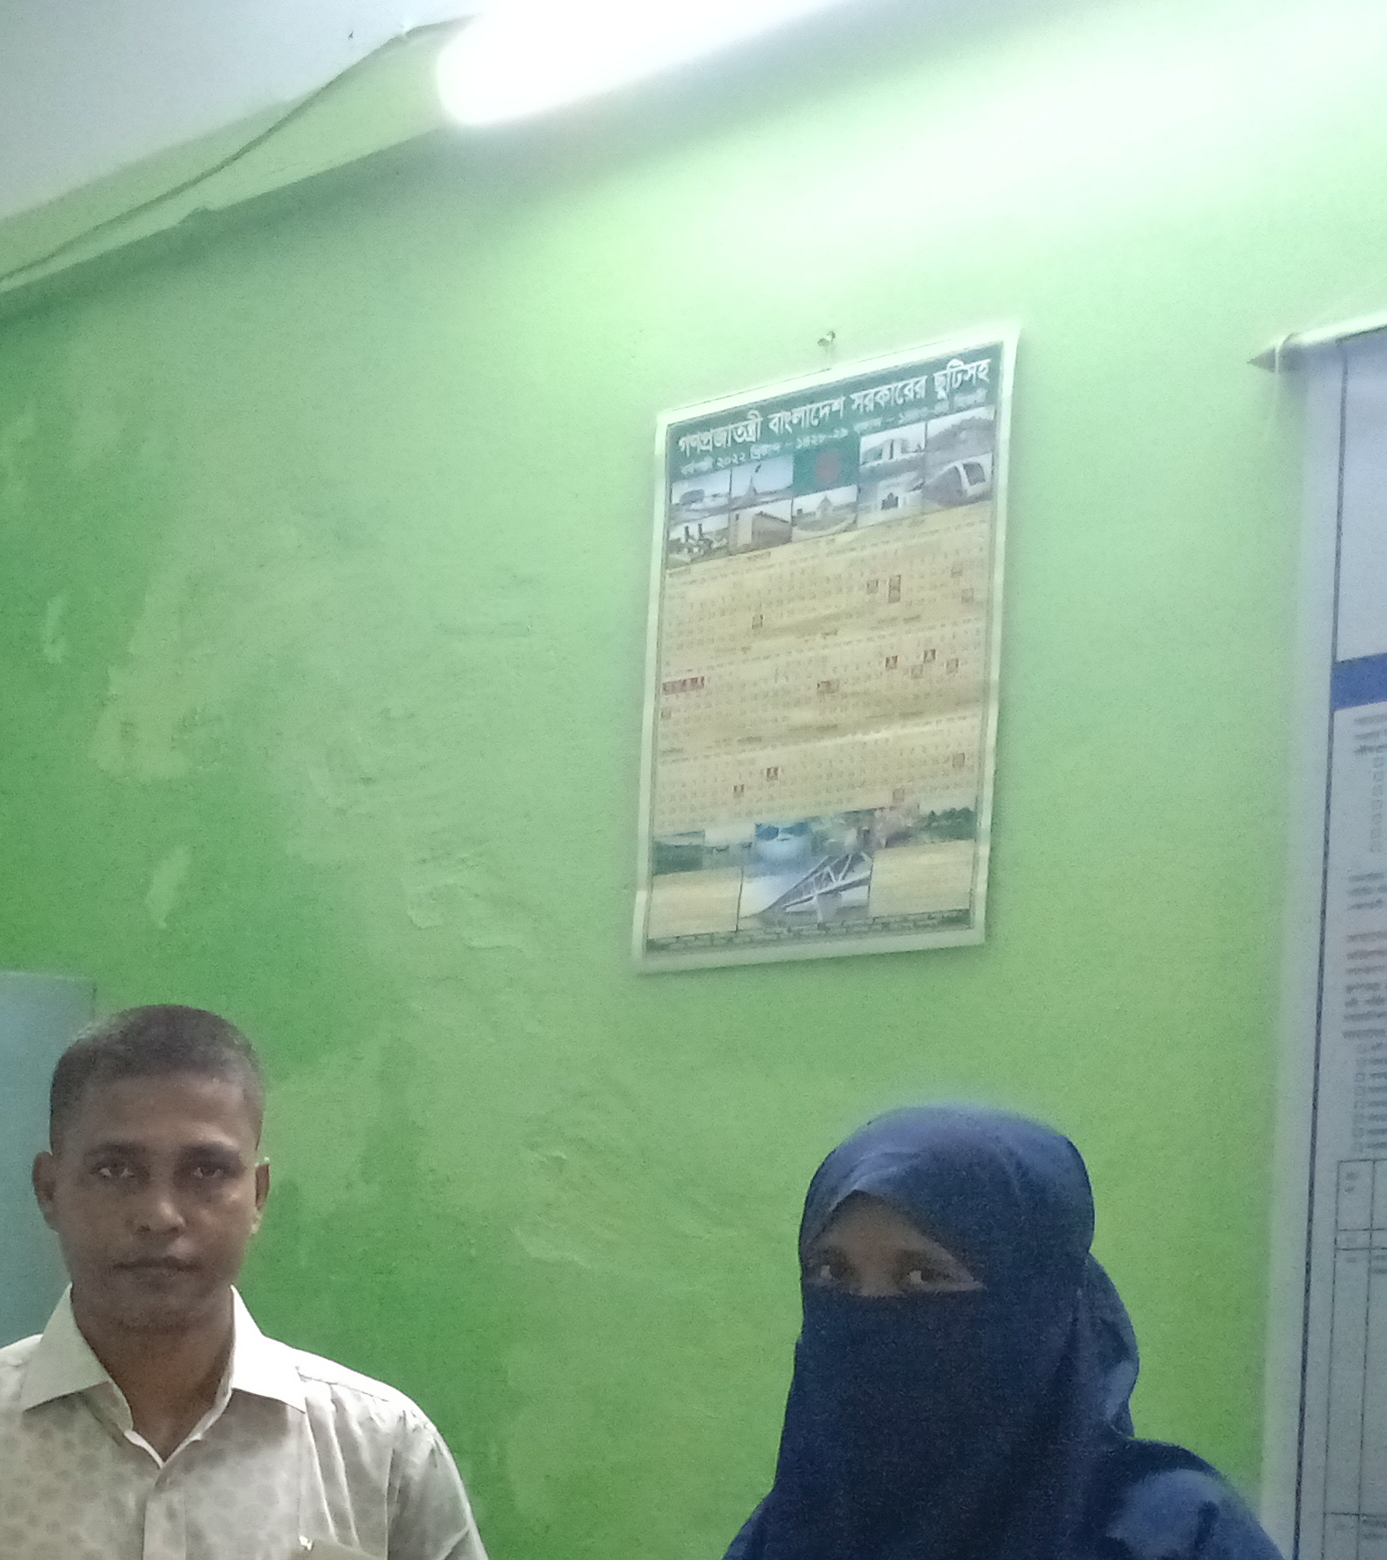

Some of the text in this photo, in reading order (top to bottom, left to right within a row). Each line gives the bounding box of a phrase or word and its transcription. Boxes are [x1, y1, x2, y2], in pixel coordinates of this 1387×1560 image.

[767, 396, 846, 436] বাংলাদেশ
[849, 374, 929, 414] সরকারের
[932, 358, 992, 402] ছুটিসহ
